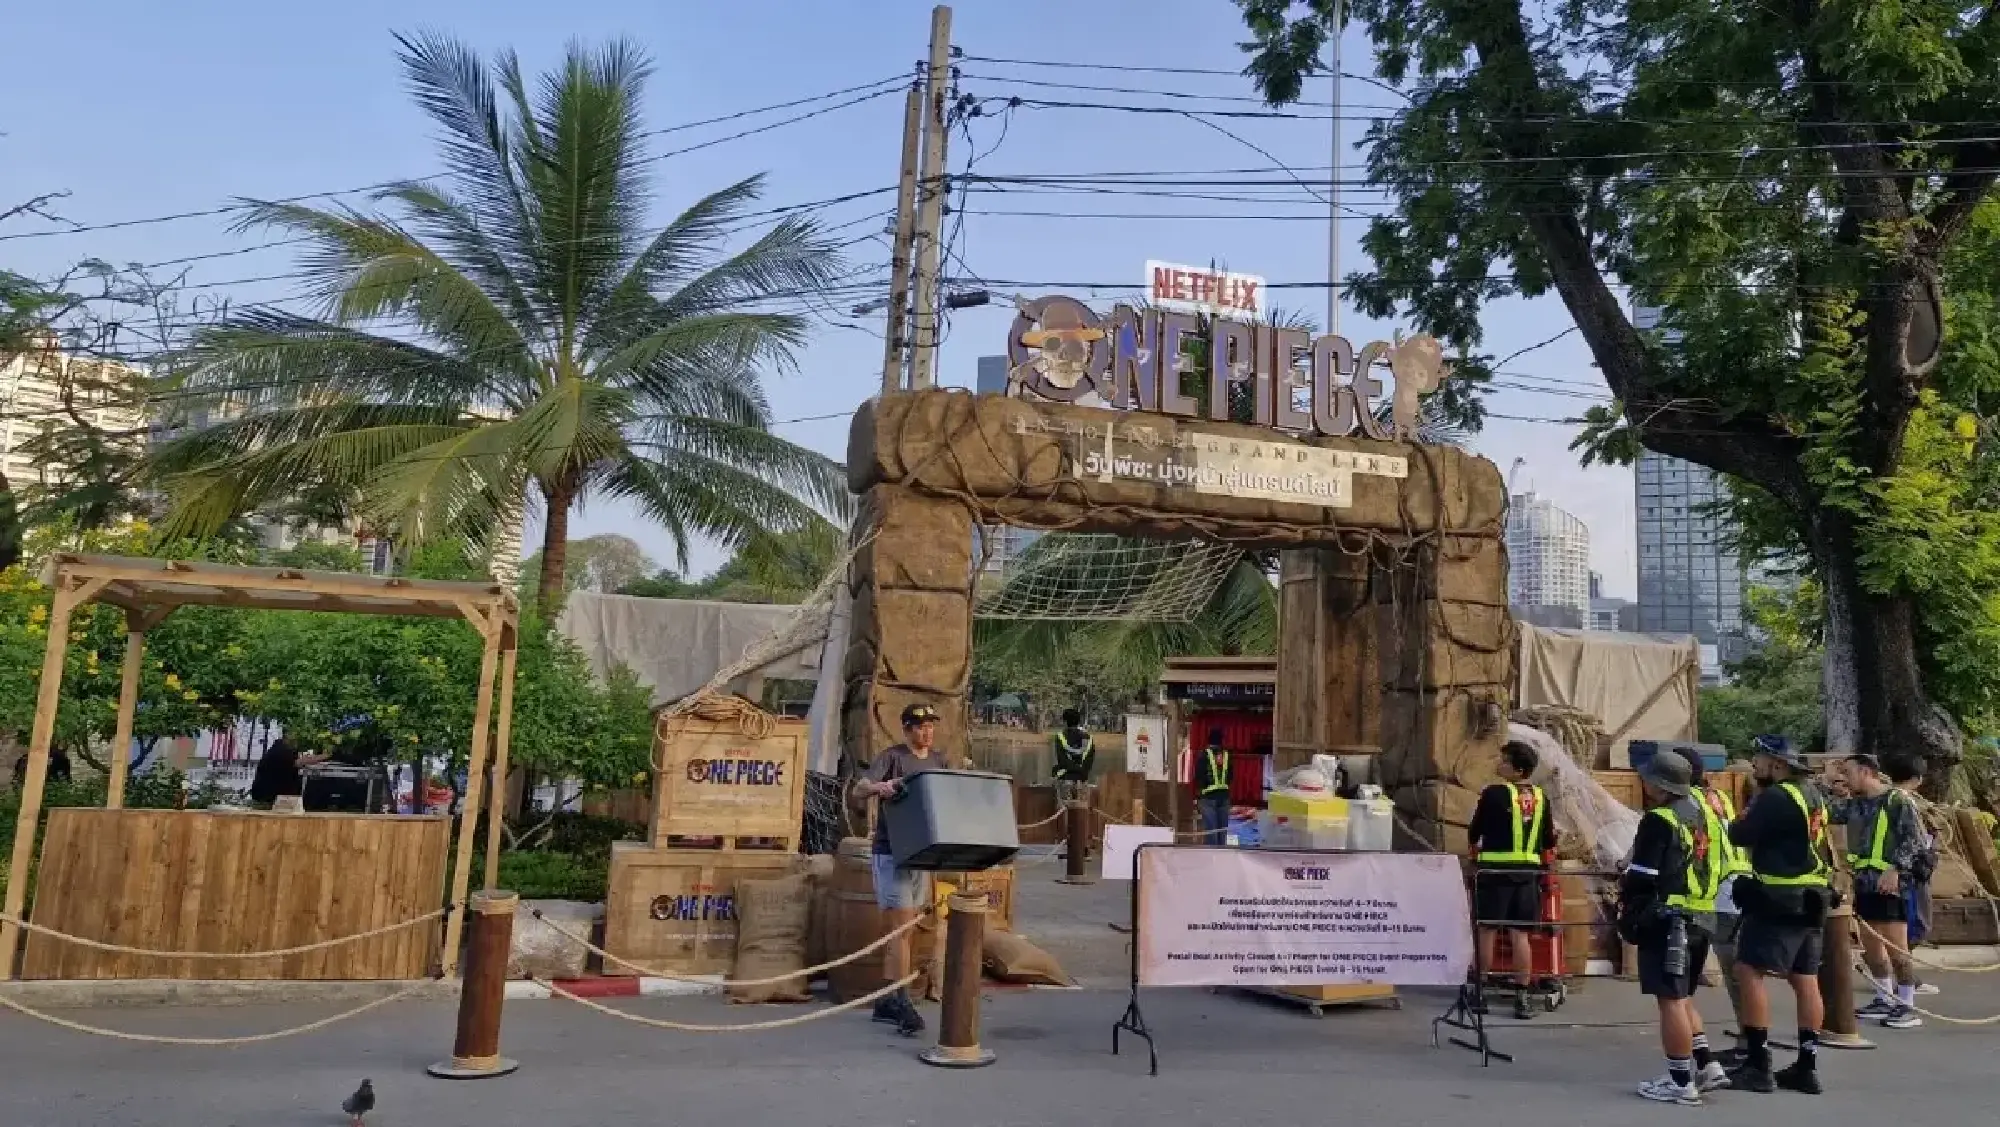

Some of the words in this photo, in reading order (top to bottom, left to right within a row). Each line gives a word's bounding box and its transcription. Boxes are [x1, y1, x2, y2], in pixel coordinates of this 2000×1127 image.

[1152, 266, 1258, 312] NETFLIX
[1007, 294, 1199, 417] ONE
[1209, 317, 1400, 441] PIECE
[1208, 440, 1308, 464] GRAND
[1332, 453, 1401, 474] LINE
[687, 758, 733, 785] ONE
[735, 759, 786, 786] PIECE
[650, 894, 699, 920] ONE
